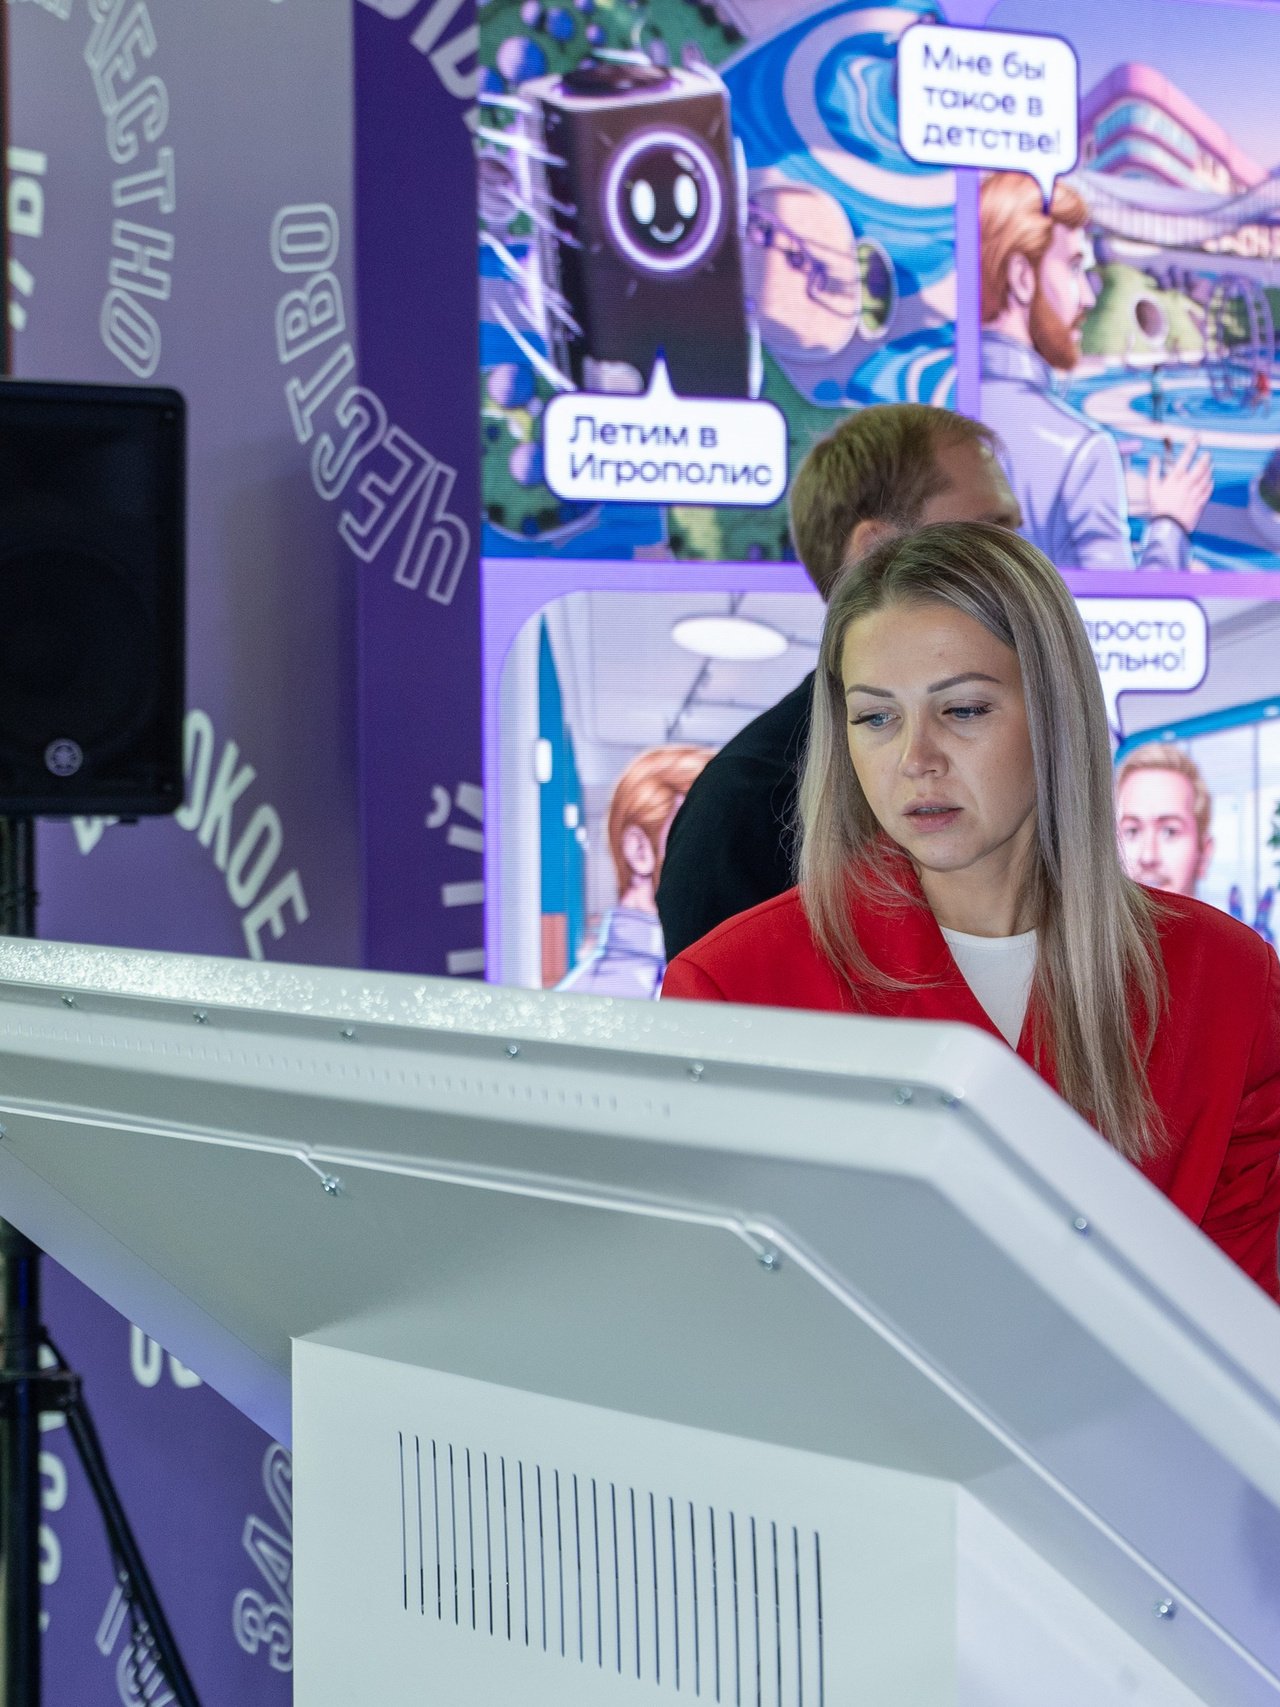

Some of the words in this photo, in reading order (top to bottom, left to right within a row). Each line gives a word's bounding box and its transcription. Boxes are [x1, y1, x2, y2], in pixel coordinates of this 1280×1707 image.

[923, 43, 992, 76] Мне
[1003, 51, 1046, 80] бы
[923, 86, 1017, 115] такое
[1027, 95, 1044, 117] в
[922, 122, 1061, 155] детстве!
[568, 414, 690, 446] Летим
[699, 427, 718, 448] в
[569, 452, 773, 488] Игрополис
[1095, 646, 1186, 672] льно!
